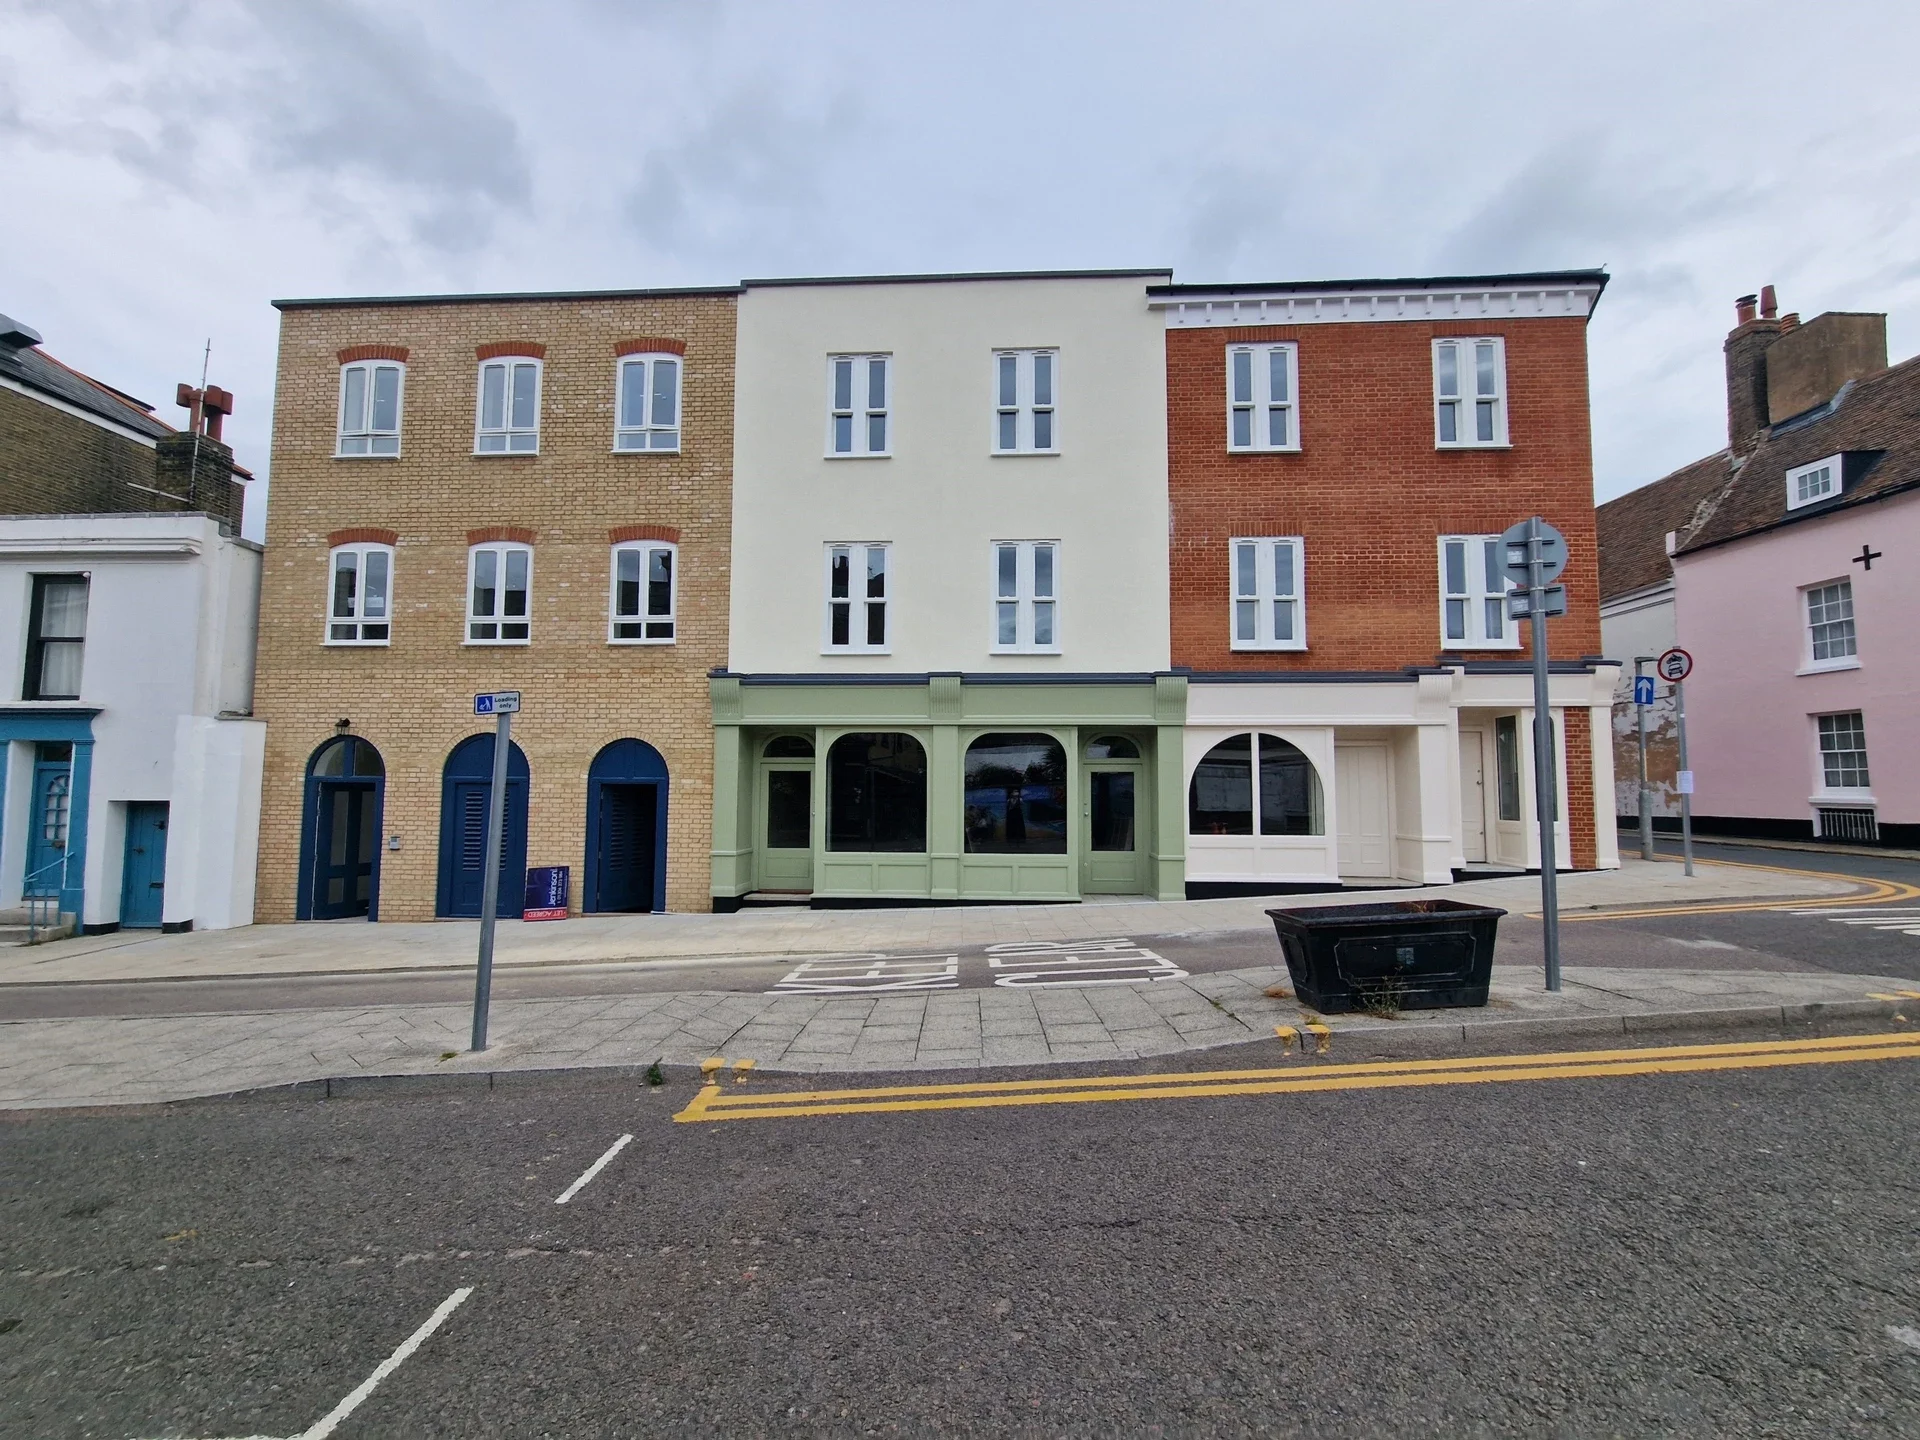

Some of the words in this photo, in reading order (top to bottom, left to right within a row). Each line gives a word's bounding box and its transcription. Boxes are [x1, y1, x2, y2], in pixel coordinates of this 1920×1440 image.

[548, 870, 557, 906] Jenkinson
[763, 953, 959, 995] KEEP
[984, 938, 1189, 987] CLEAR
